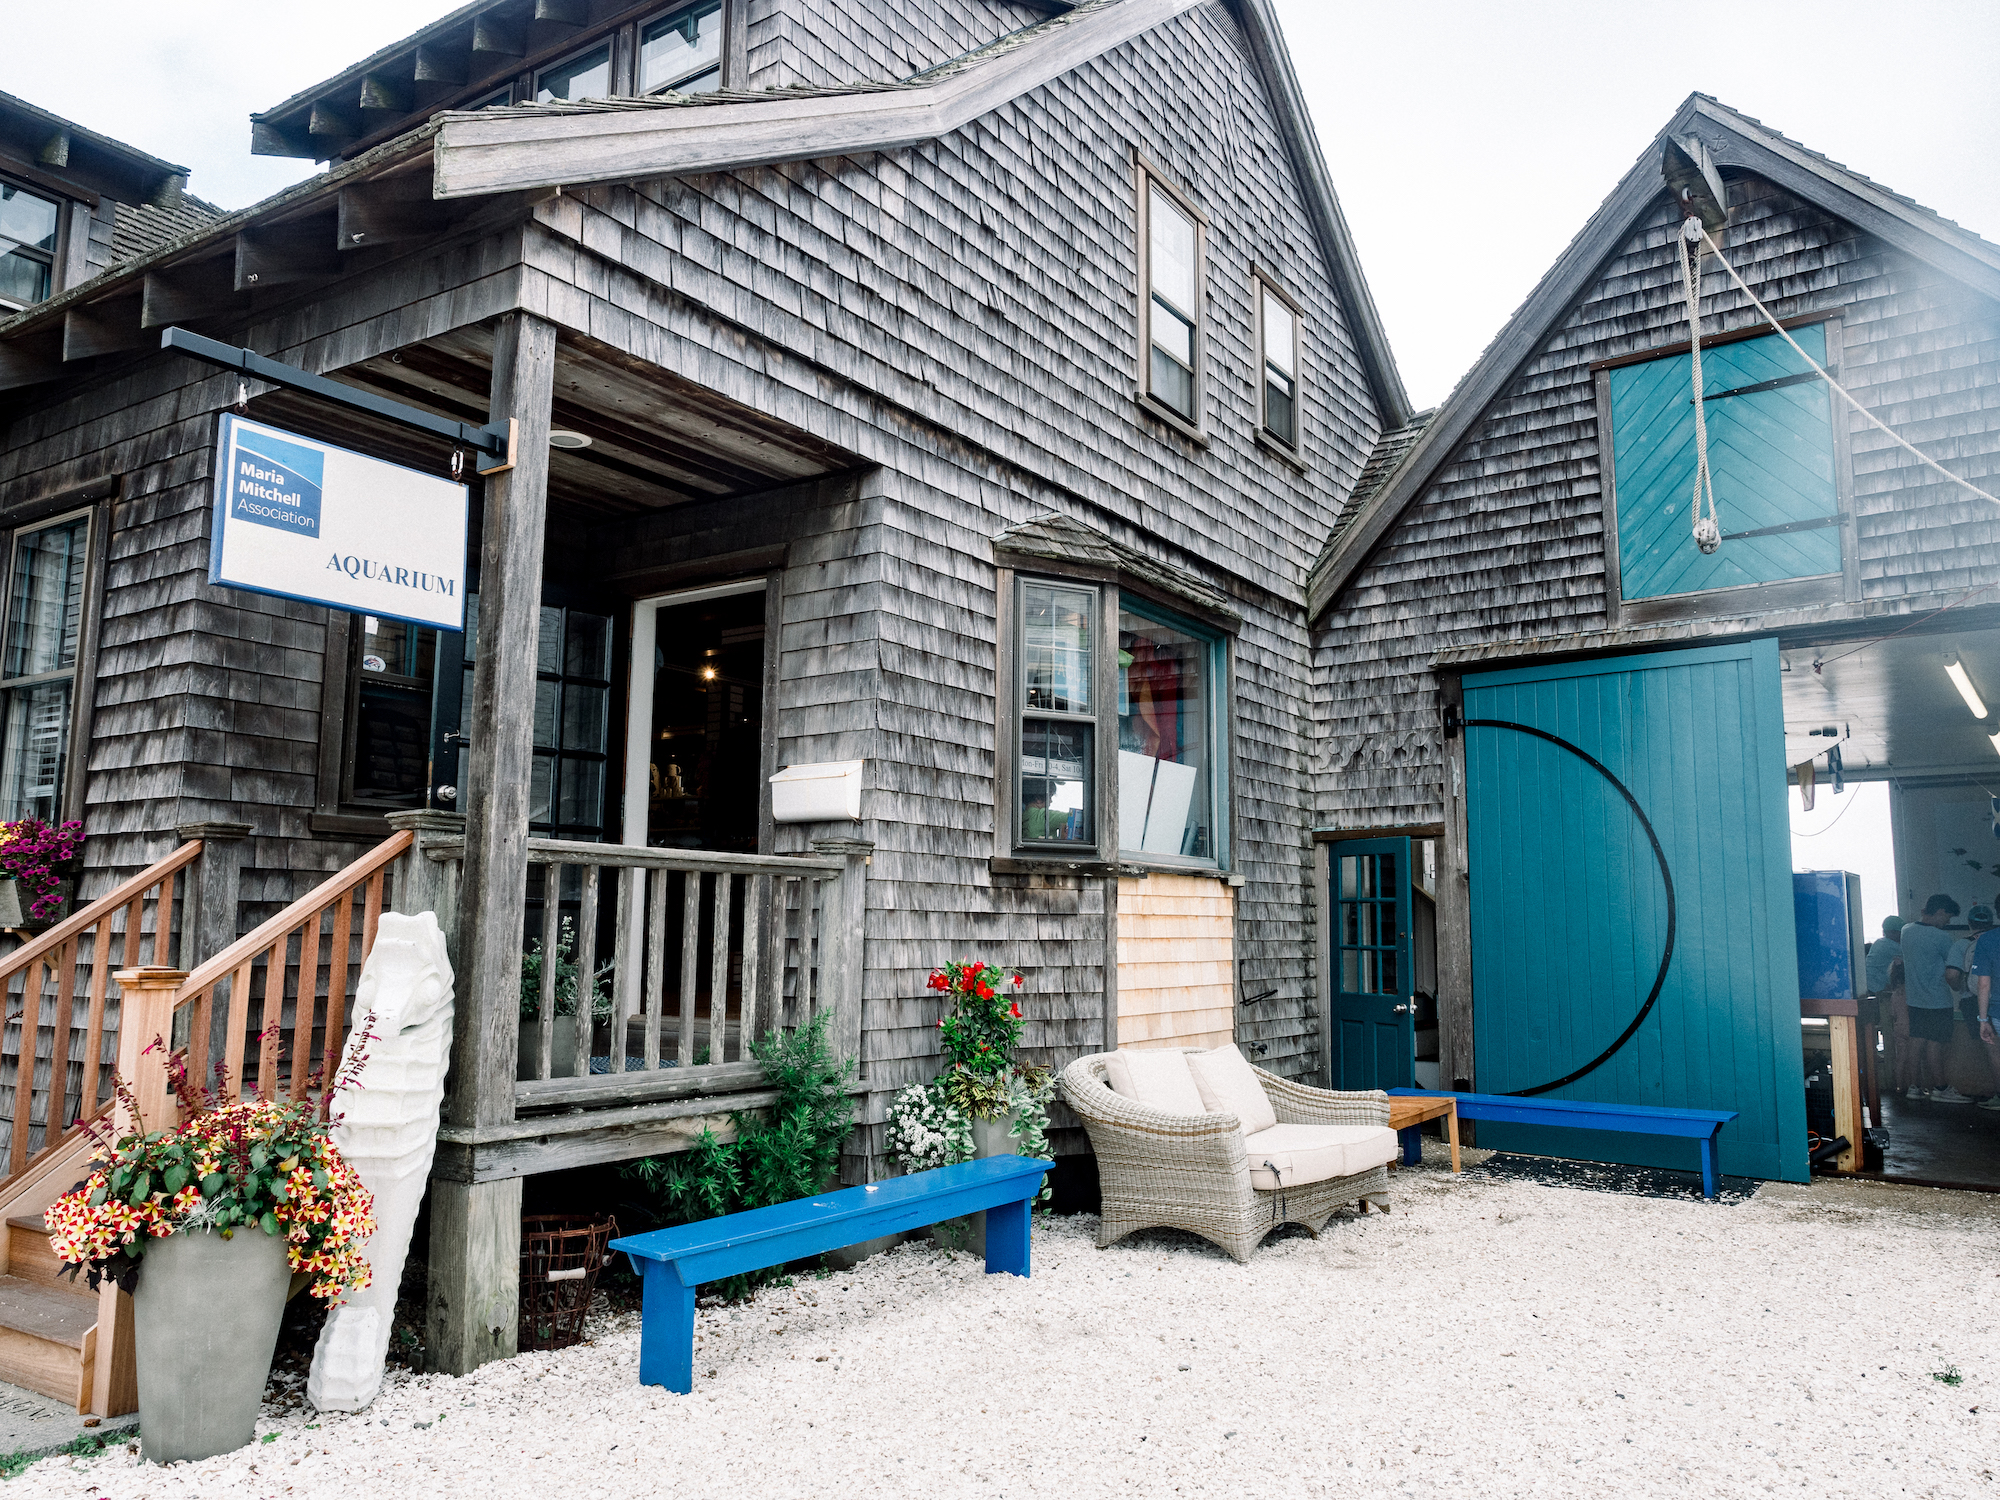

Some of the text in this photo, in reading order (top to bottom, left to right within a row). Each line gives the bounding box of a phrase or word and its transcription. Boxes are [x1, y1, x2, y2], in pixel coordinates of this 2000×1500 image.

[240, 461, 285, 486] Maria
[239, 479, 301, 508] Mitchell
[237, 498, 315, 529] Association
[326, 552, 456, 597] AQUARIUM
